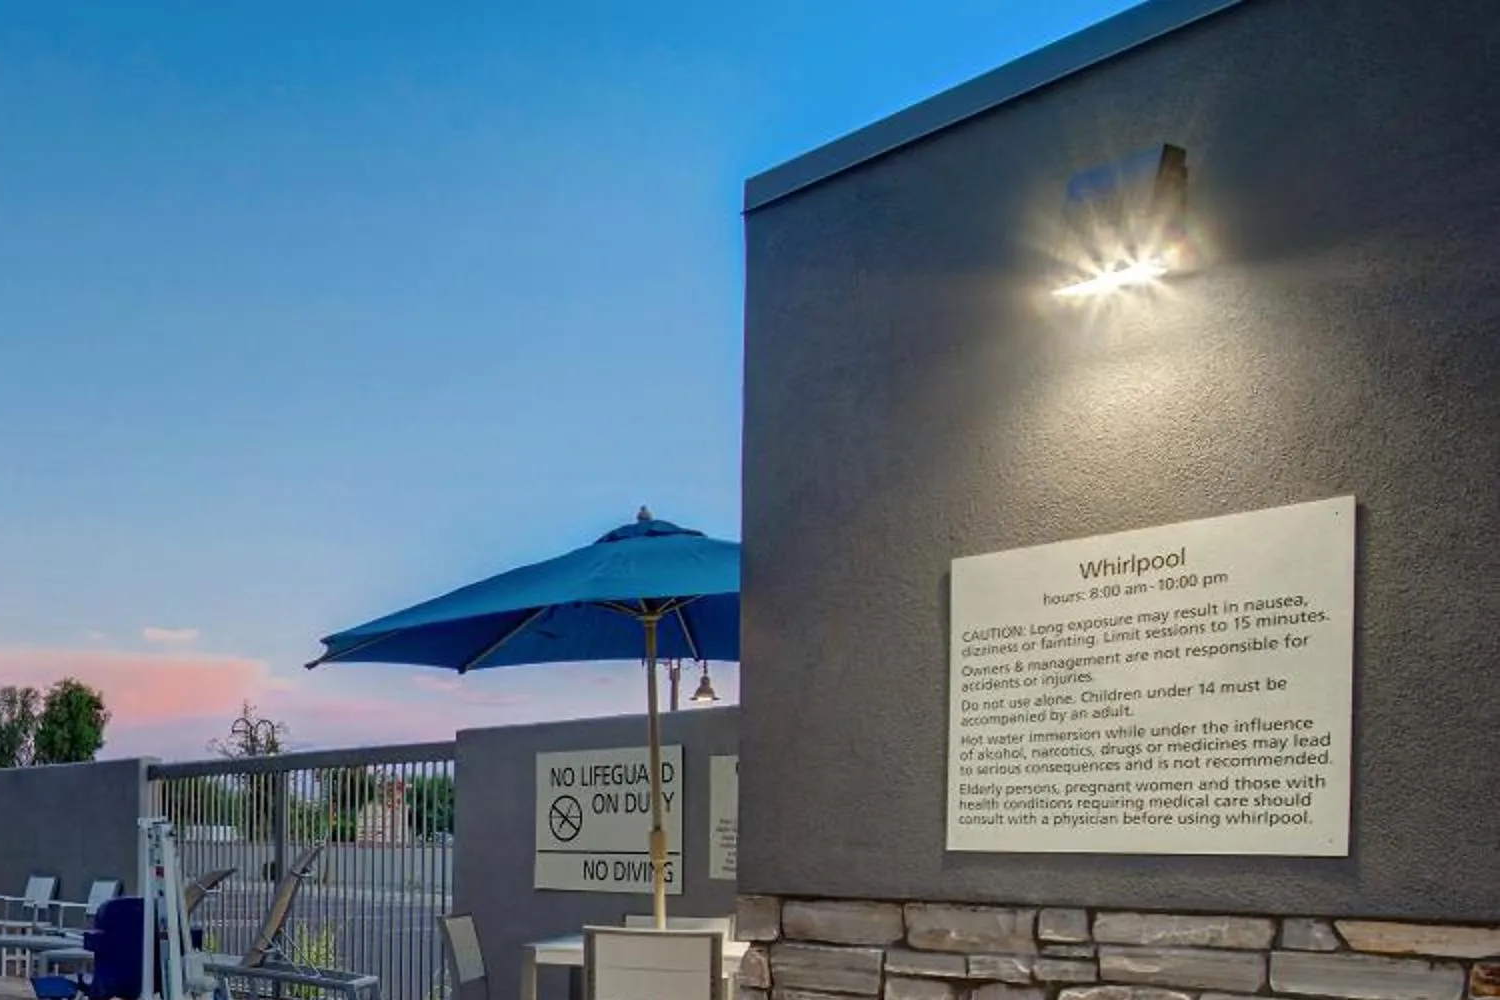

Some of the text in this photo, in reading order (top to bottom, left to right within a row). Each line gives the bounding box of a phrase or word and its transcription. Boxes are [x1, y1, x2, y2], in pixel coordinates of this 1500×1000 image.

[1079, 546, 1186, 579] Whirlpool
[1043, 591, 1085, 605] hours:
[1089, 584, 1121, 599] 8:00
[1159, 574, 1198, 590] 10:00
[1203, 572, 1228, 588] pm
[962, 595, 1308, 642] CAUTION: Long exposure may result in nausea,
[962, 643, 1018, 657] dizziness
[1022, 640, 1036, 651] or
[1103, 629, 1141, 643] Limit
[1145, 623, 1206, 639] sessions
[1211, 620, 1227, 632] to
[1234, 616, 1250, 631] 15
[1256, 610, 1330, 628] minutes.
[962, 633, 1309, 677] Owners & management are not responsible for
[962, 677, 1020, 692] accidents
[1023, 677, 1036, 687] or
[962, 700, 978, 711] Do
[983, 699, 1004, 710] not
[1008, 698, 1030, 708] use
[1081, 687, 1142, 703] Children
[1147, 684, 1193, 699] under
[1199, 682, 1215, 695] 14
[1220, 680, 1260, 693] must
[1267, 677, 1287, 691] be
[961, 705, 1133, 727] accompanied by an adult.
[961, 717, 1314, 745] Hot water immersion while under the influence
[960, 749, 973, 761] of
[1101, 743, 1142, 758] drugs
[1147, 742, 1162, 753] or
[1168, 738, 1247, 753] medicines
[1253, 737, 1288, 752] may
[1293, 732, 1331, 747] lead
[551, 763, 674, 787] NO LIFEGUAD
[960, 750, 1332, 776] to serious consequences and is not recommended.
[959, 783, 1001, 796] Elderly
[1065, 780, 1131, 796] pregnant
[1135, 779, 1193, 792] women
[1197, 776, 1229, 791] and
[1235, 775, 1281, 790] those
[1286, 774, 1326, 789] with
[592, 792, 674, 814] ON DUY
[959, 792, 1312, 811] health conditions requiring medical care should
[959, 810, 1312, 829] consult with a physician before using whirlpool.
[583, 860, 608, 881] NO
